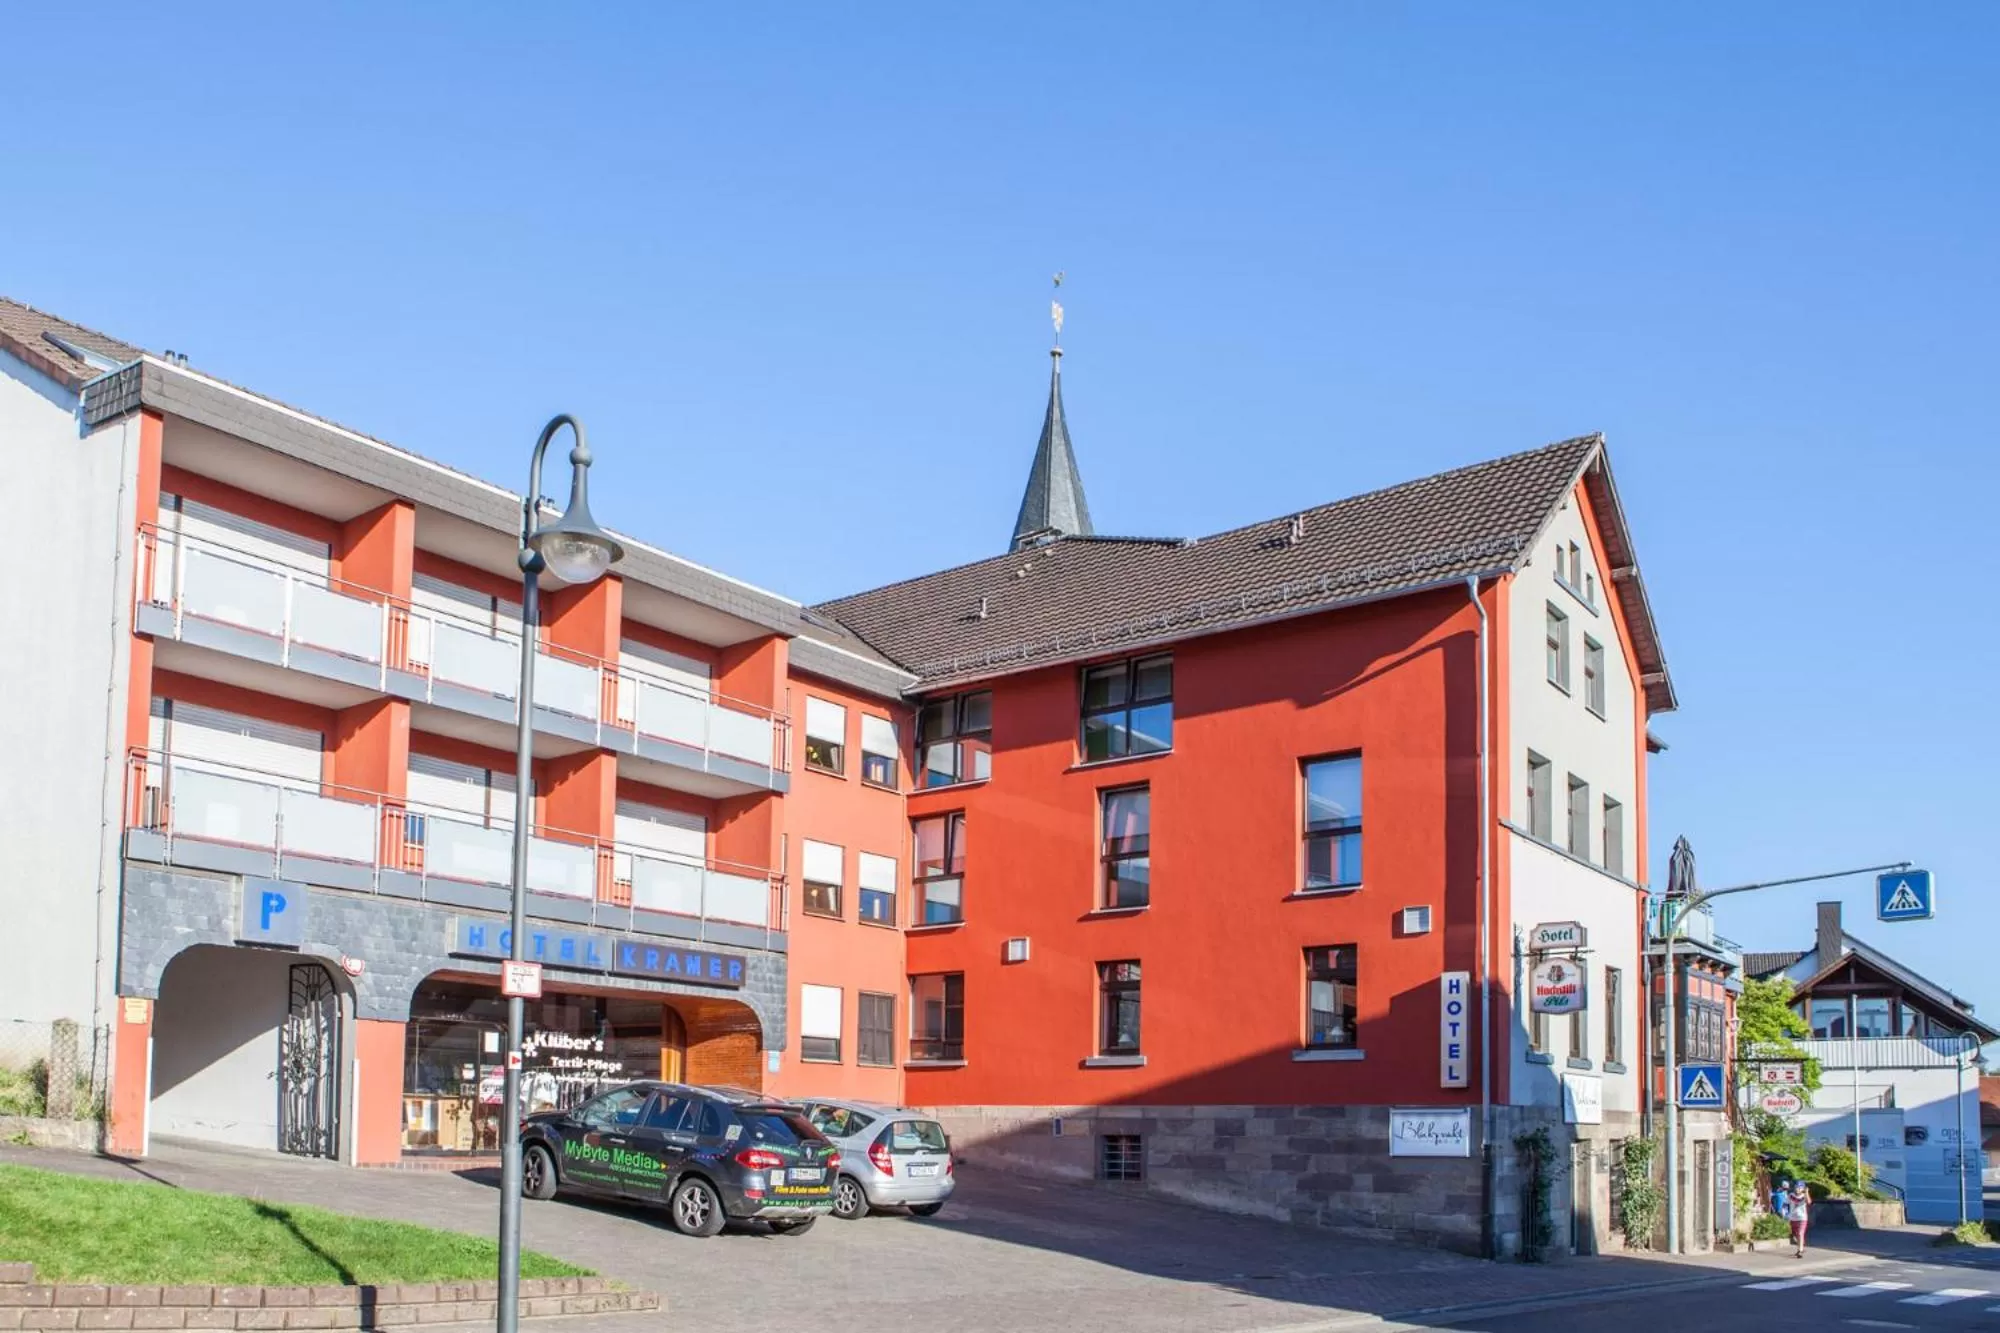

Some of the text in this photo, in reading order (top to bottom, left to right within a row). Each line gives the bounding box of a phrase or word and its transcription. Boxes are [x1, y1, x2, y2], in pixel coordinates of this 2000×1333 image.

[261, 891, 287, 930] P
[1539, 928, 1573, 943] Hotel
[623, 942, 742, 982] KRAMER
[533, 1030, 604, 1052] Klüber's
[1447, 979, 1462, 1080] HOTEL
[550, 1055, 623, 1073] Textil-Pflege
[565, 1139, 652, 1170] MyByte Media
